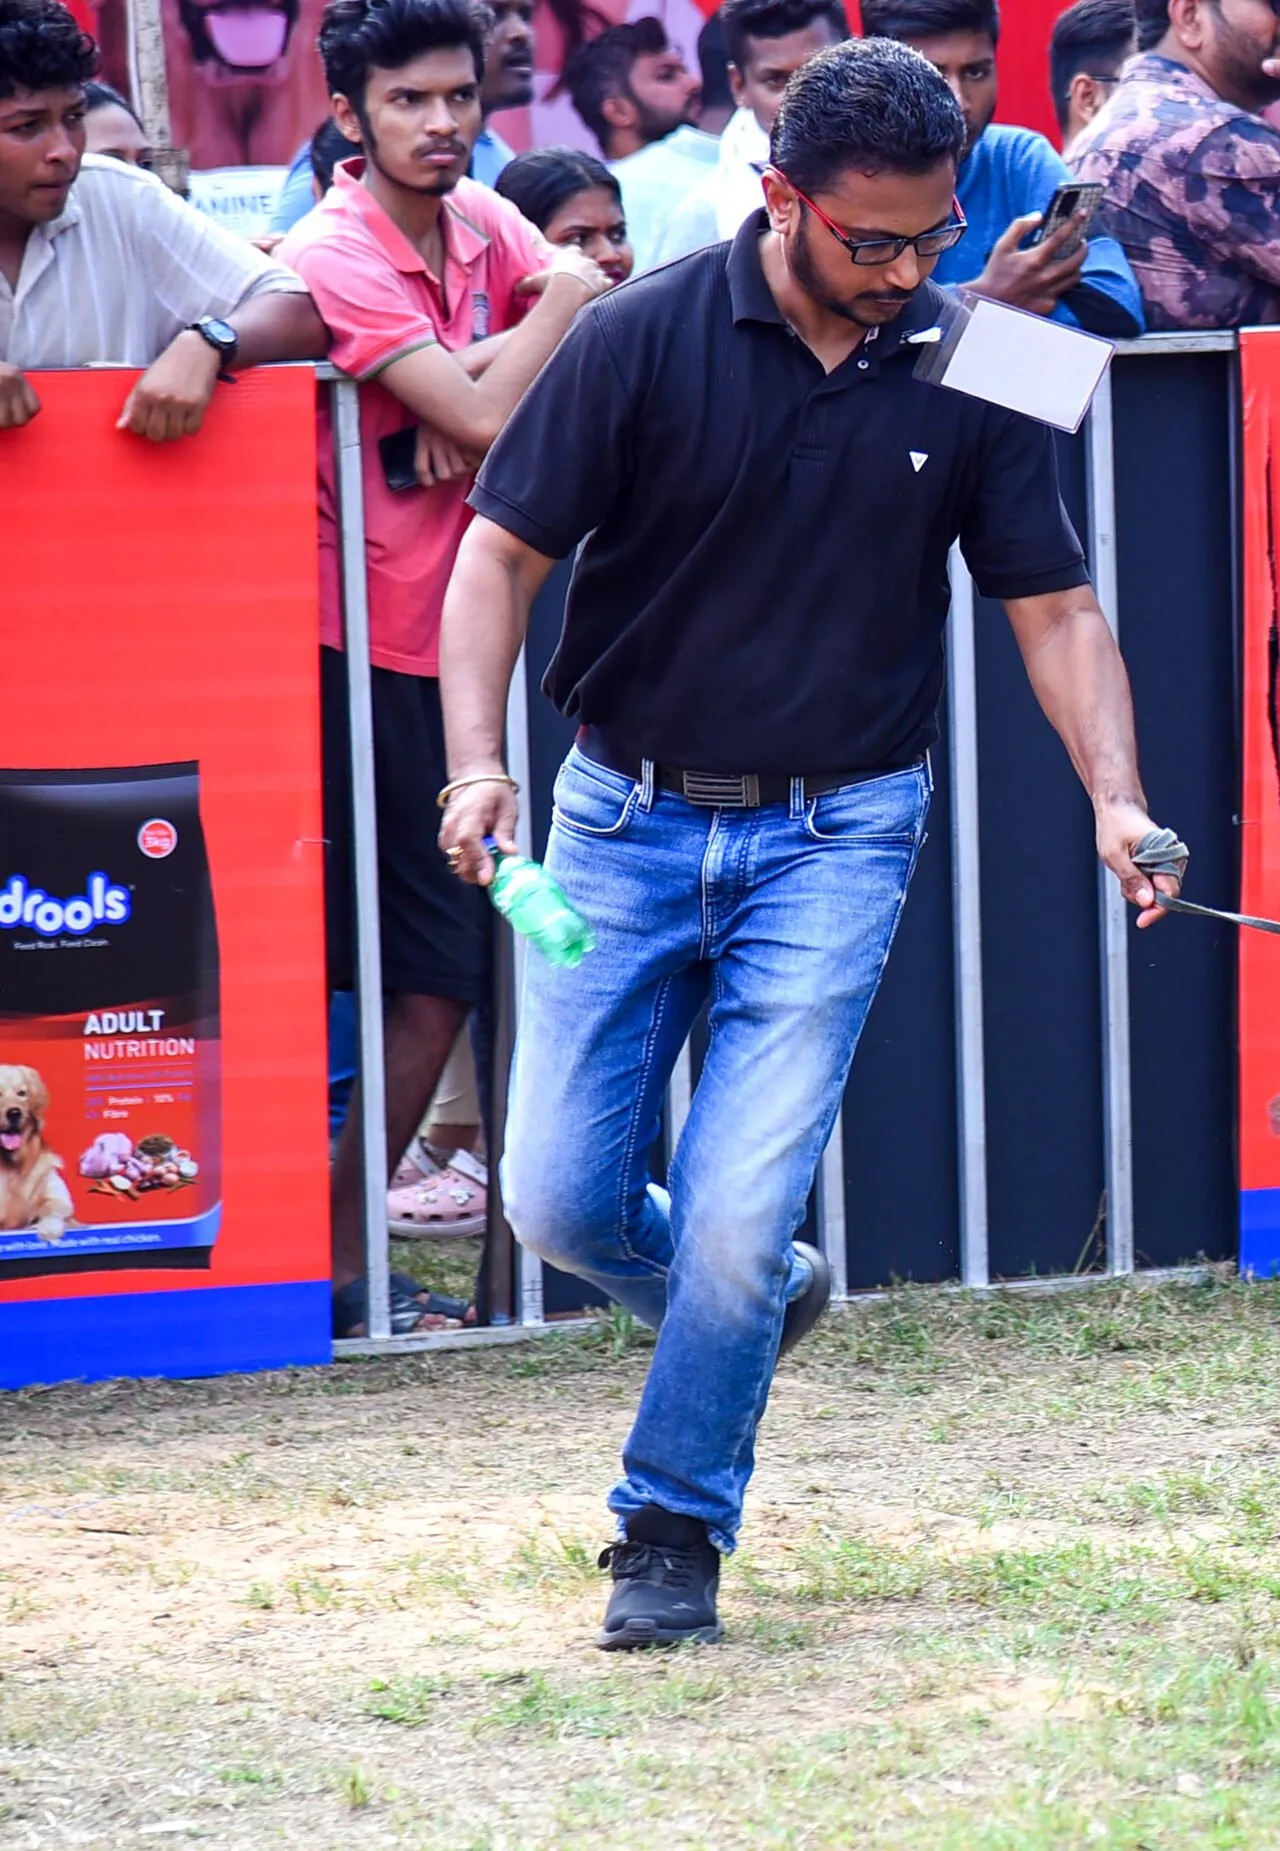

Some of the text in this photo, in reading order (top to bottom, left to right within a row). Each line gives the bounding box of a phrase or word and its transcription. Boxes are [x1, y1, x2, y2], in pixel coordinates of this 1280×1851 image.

[193, 194, 276, 216] ANINE
[0, 872, 130, 934] drools
[84, 1010, 164, 1035] ADULT
[84, 1038, 195, 1061] NUTRITION
